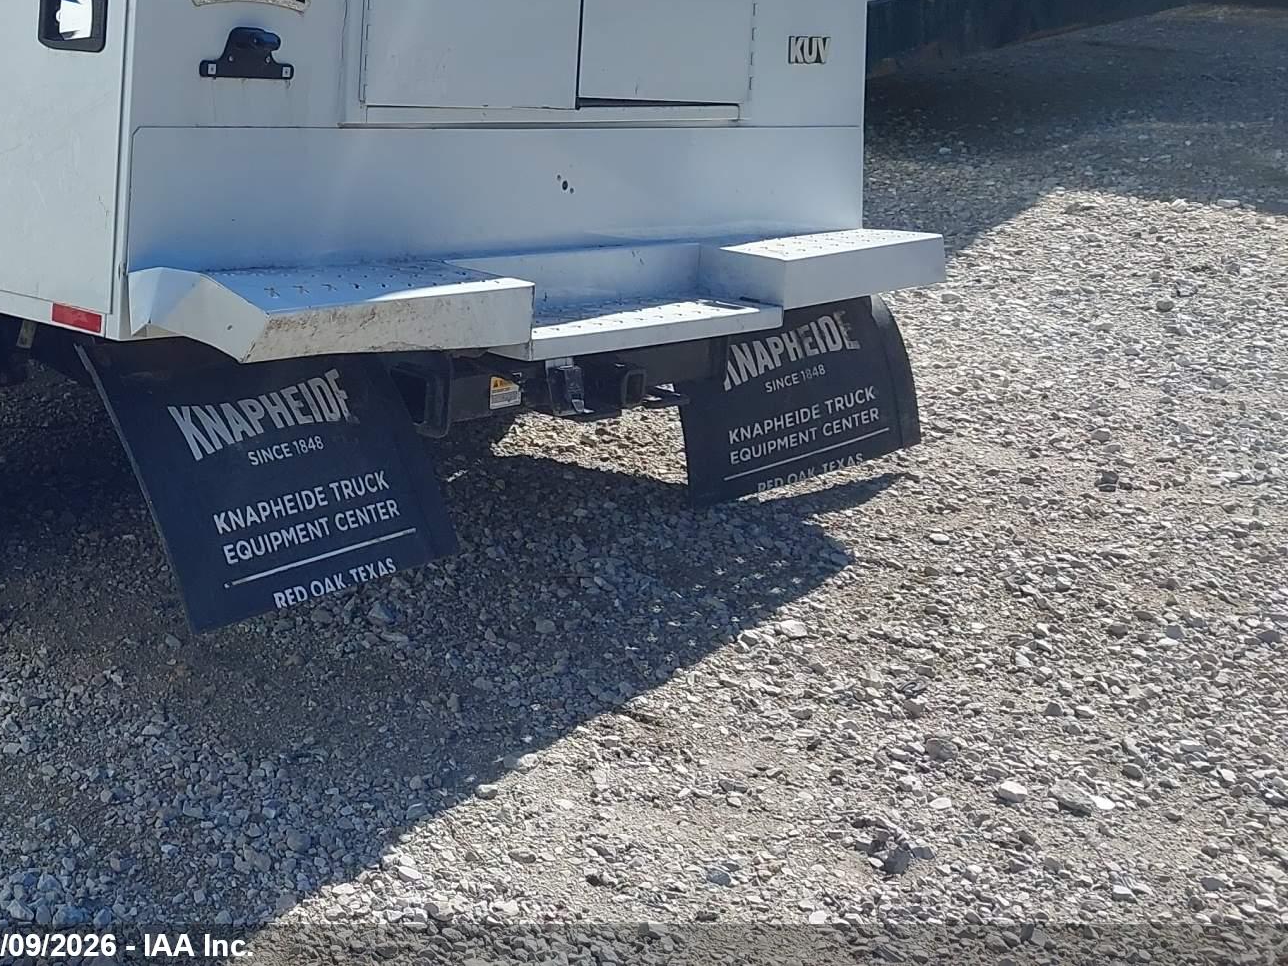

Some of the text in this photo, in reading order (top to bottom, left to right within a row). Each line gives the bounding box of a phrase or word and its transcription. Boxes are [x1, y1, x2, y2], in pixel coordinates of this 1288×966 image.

[788, 35, 832, 65] KUV
[764, 364, 827, 394] SINCE 1848
[728, 385, 876, 445] KNAPHEIDE TRUCK
[729, 407, 880, 465] EQUIPMENT CENTER
[247, 435, 325, 466] SINCE 1848
[212, 470, 390, 535] KNAPHEIDE TRUCK
[222, 498, 401, 565] EQUIPMENT CENTER
[273, 585, 309, 610] RED
[349, 557, 398, 586] TEXAS
